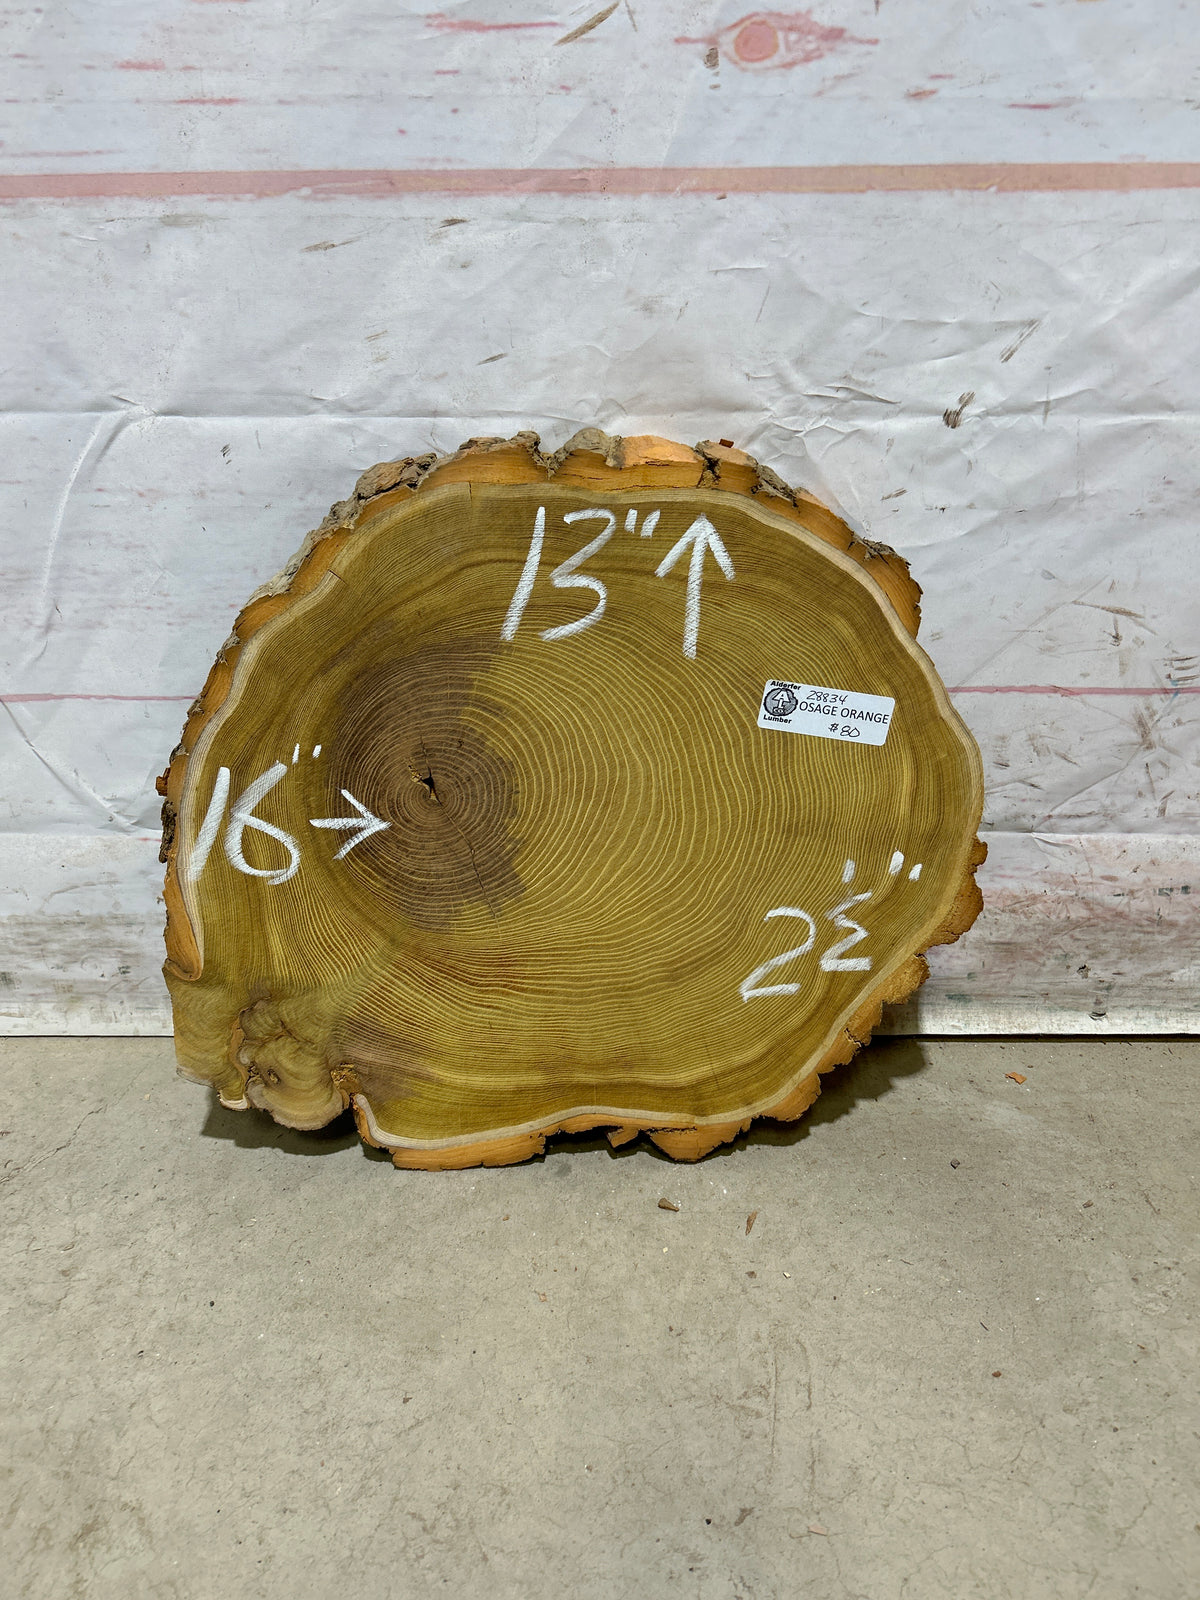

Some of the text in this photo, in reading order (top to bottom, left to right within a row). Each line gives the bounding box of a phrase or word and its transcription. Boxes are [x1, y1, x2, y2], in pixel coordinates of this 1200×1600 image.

[770, 680, 801, 691] Alderfer
[806, 690, 848, 704] 28834
[799, 701, 890, 724] OSAGE ORANGE
[763, 714, 792, 724] Lumber
